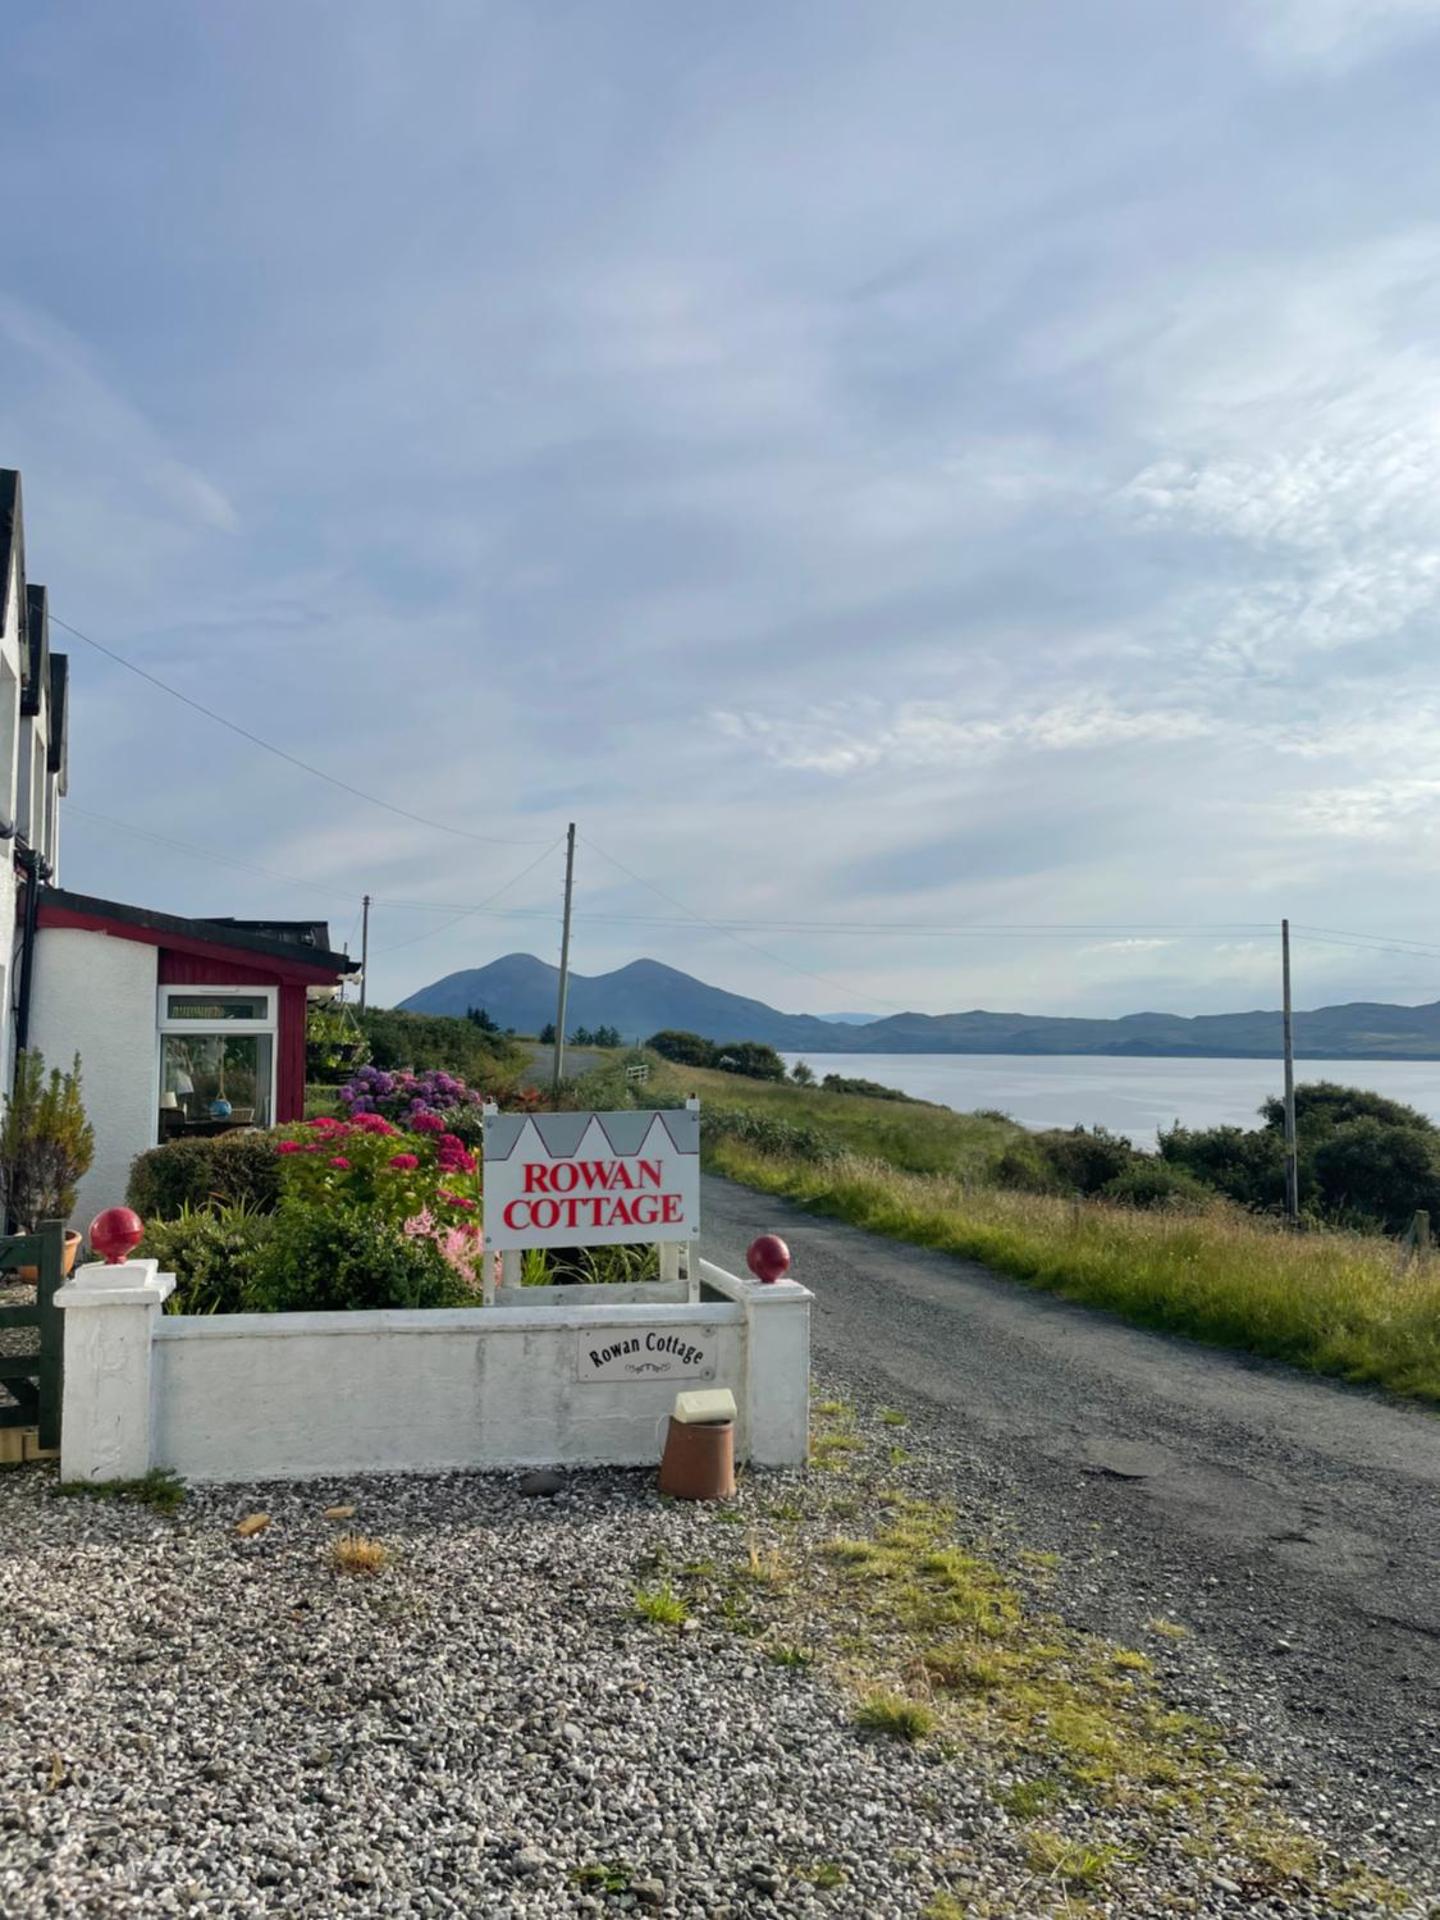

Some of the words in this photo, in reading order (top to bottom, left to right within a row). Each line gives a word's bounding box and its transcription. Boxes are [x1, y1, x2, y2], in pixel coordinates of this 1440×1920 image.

[522, 1160, 663, 1193] ROWAN
[503, 1194, 684, 1230] COTTAGE
[589, 1338, 640, 1368] Rowan
[646, 1332, 704, 1365] Cottage
